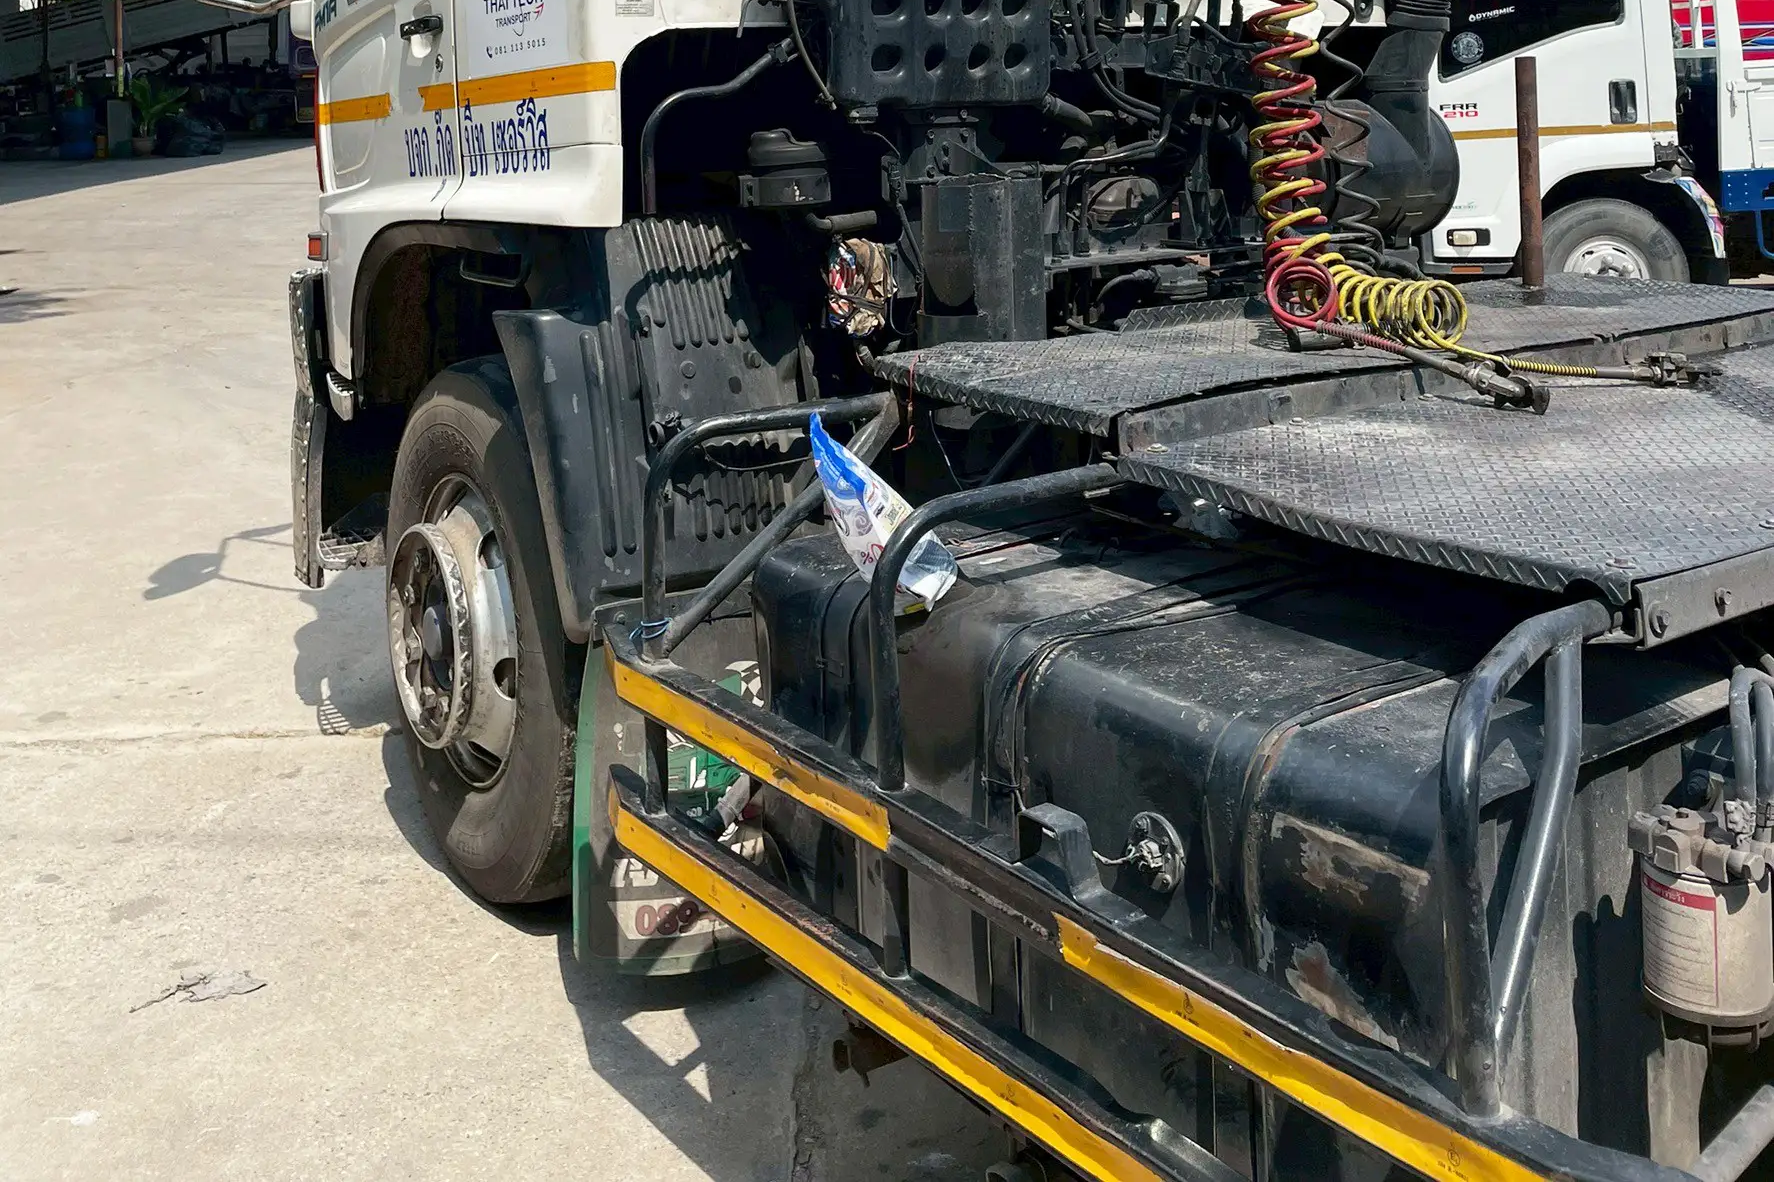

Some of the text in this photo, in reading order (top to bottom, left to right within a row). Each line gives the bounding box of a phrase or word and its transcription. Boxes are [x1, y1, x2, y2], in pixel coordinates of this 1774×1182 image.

[495, 11, 532, 28] TRANSPORT
[1475, 5, 1516, 21] DYNAMIC
[494, 37, 546, 56] 081 113 5015
[1439, 102, 1478, 111] FRR
[1443, 110, 1479, 119] 210
[491, 96, 550, 175] เซอร์วิส
